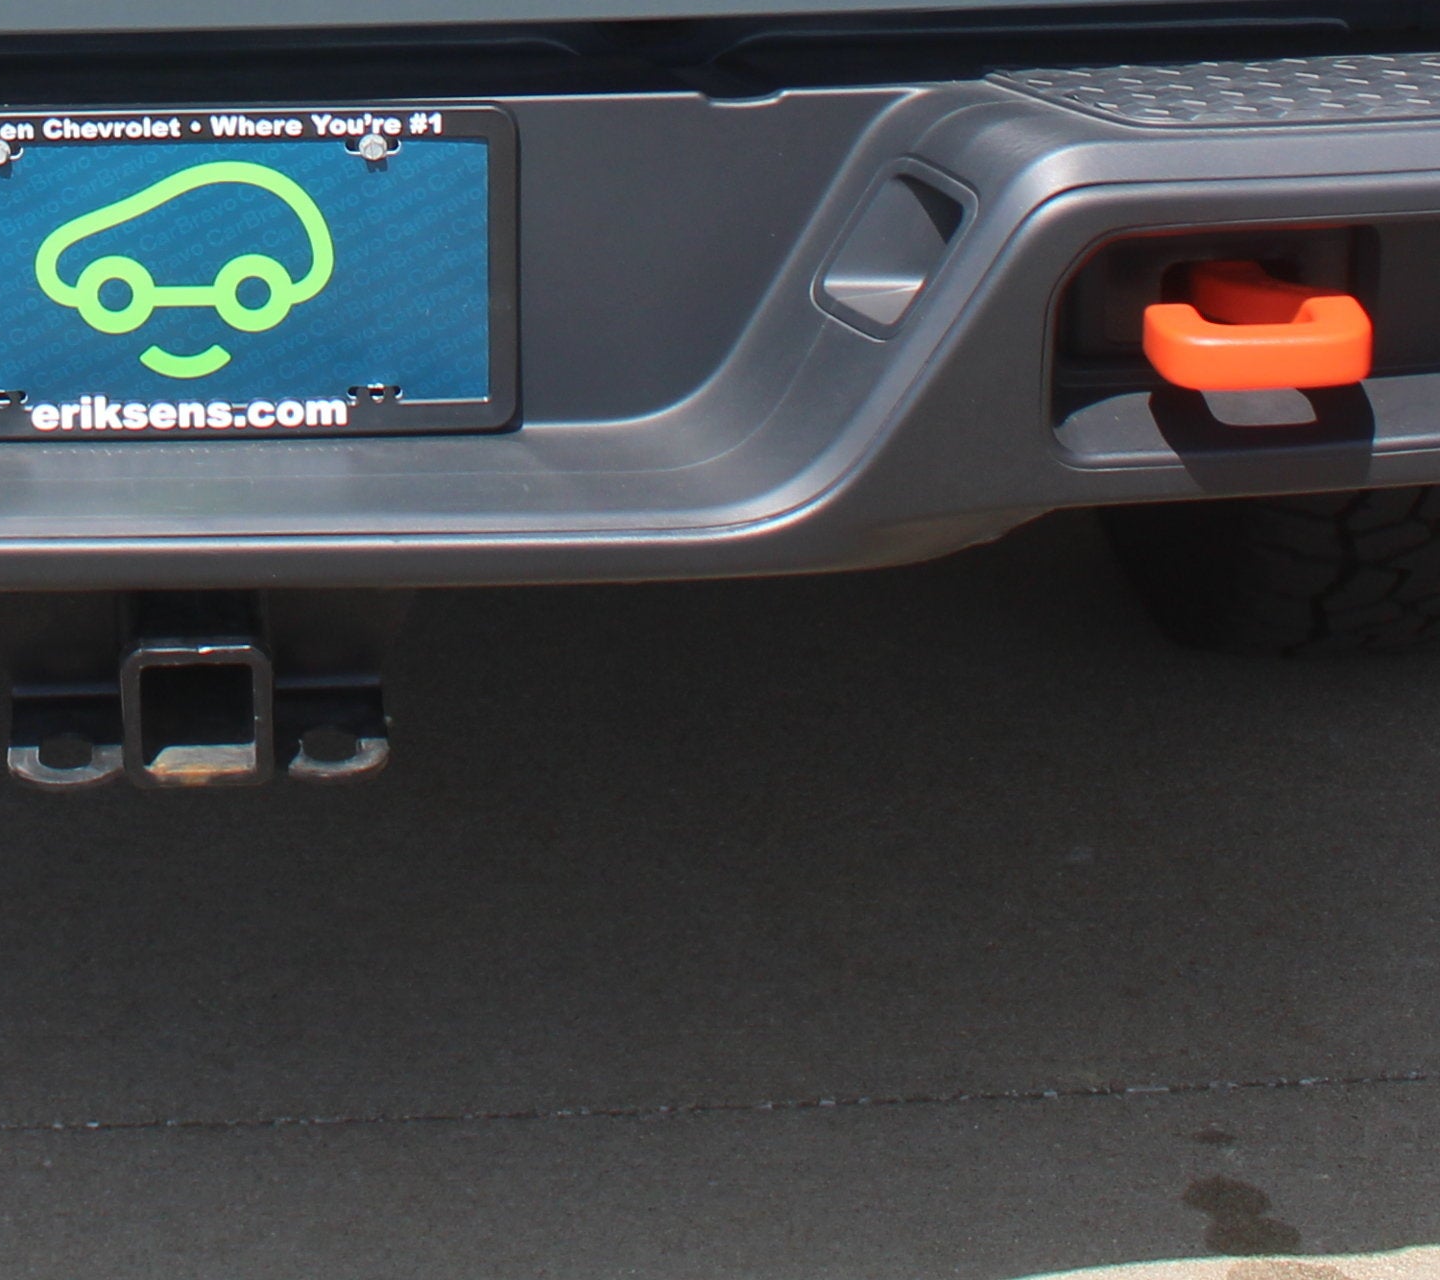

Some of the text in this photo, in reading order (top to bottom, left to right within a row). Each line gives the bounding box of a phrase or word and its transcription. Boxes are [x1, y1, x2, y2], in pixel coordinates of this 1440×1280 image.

[41, 116, 182, 140] Chevrolet
[209, 114, 304, 138] Where
[309, 112, 403, 137] You're
[408, 112, 443, 135] #1
[30, 394, 349, 431] eriksens.com
